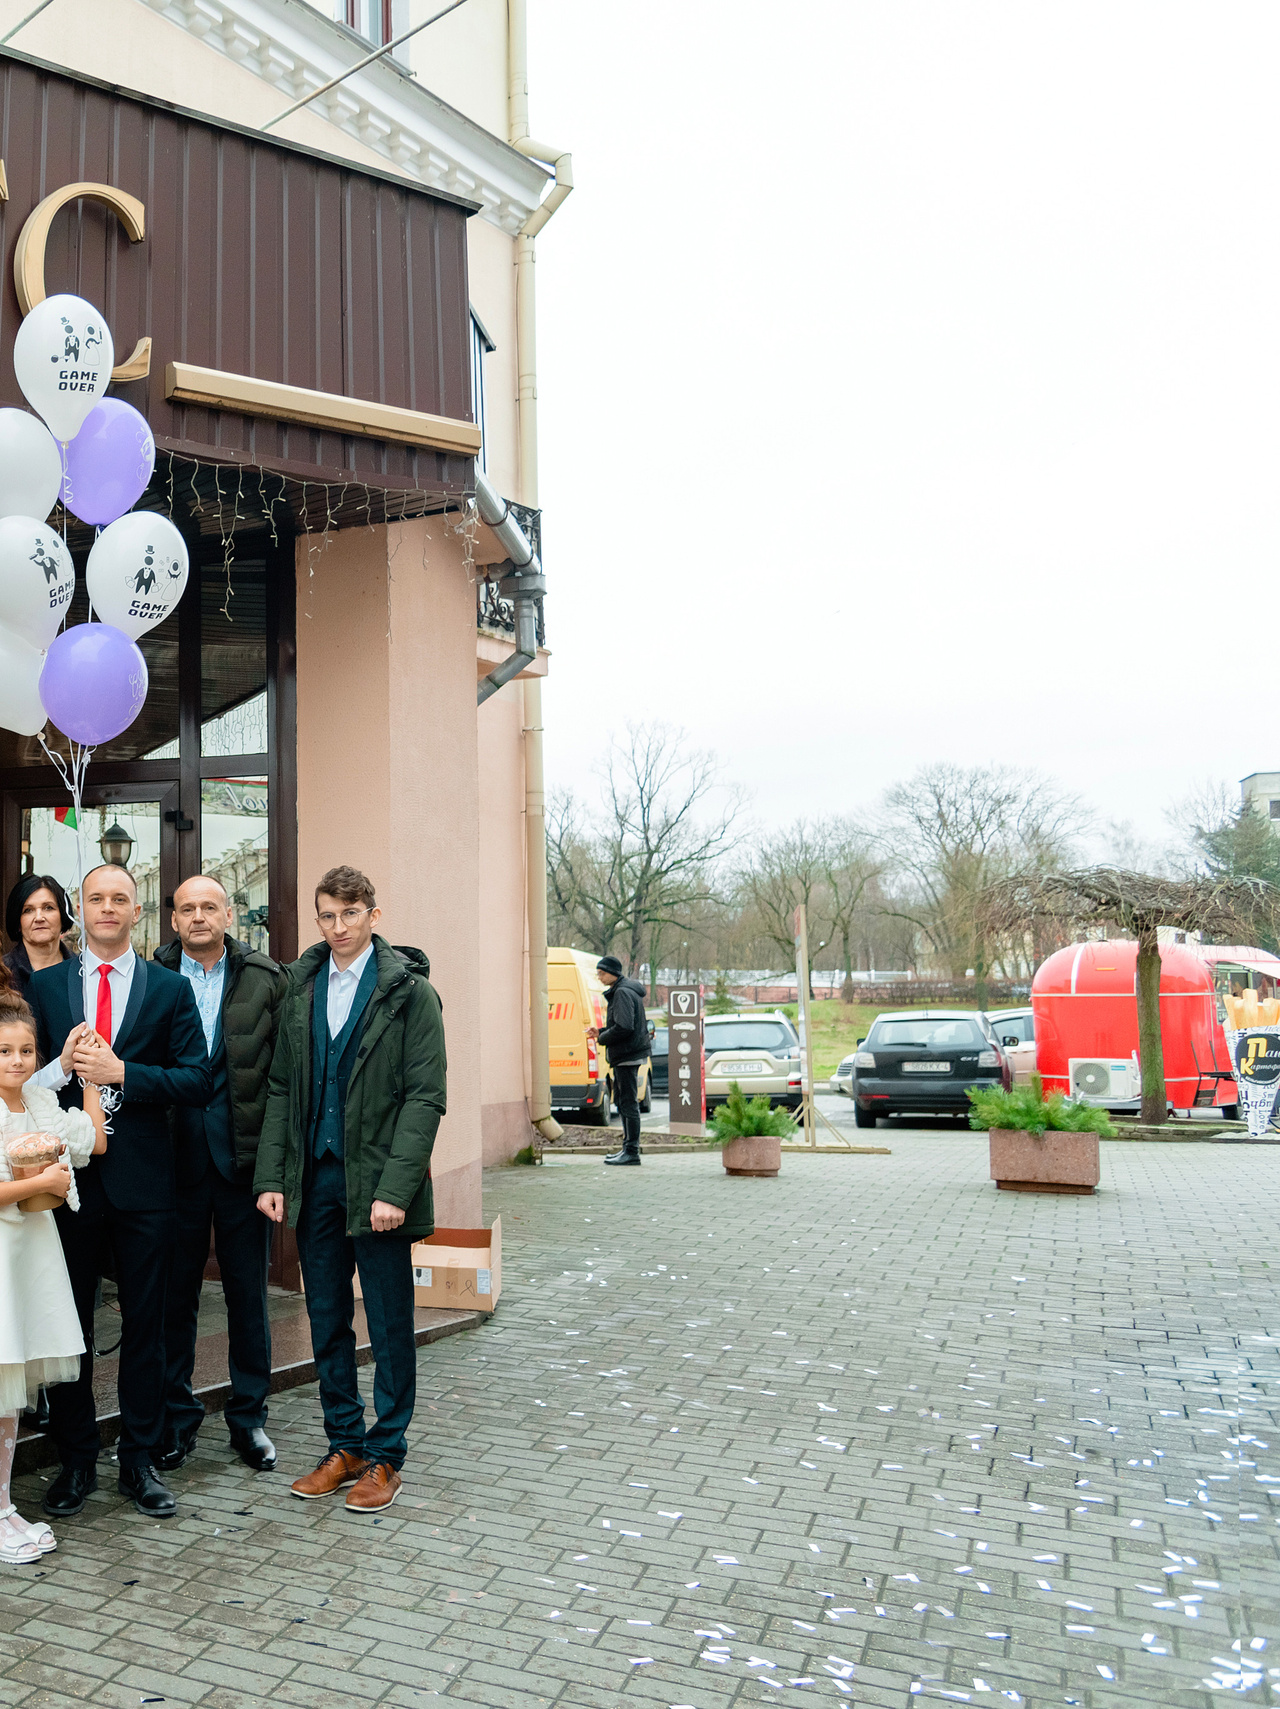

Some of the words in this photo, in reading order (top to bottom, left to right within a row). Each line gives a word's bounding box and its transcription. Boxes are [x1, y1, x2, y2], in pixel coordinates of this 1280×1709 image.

[59, 370, 99, 382] GAME
[58, 381, 95, 393] OVER
[49, 578, 75, 598] GAME
[131, 599, 170, 612] GAME
[128, 608, 164, 620] OVER
